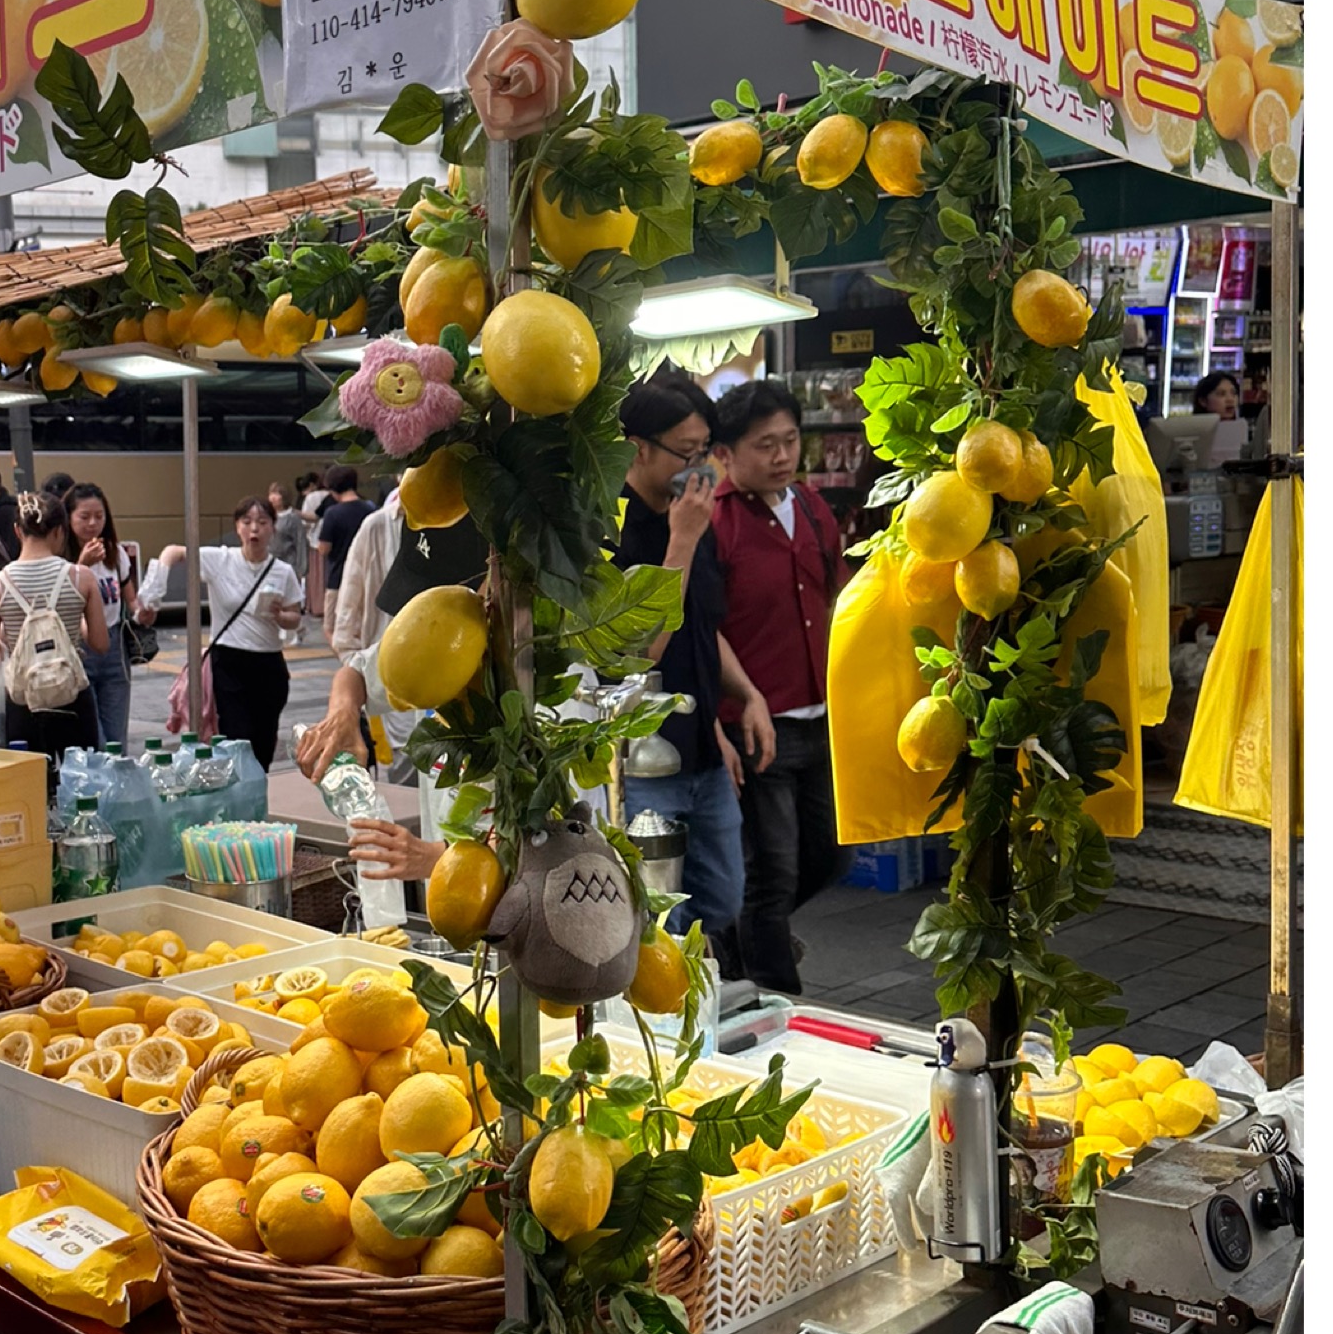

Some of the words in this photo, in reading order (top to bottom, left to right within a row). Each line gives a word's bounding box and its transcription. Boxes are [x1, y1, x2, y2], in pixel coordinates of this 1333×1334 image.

[1023, 73, 1117, 137] レモンエード
